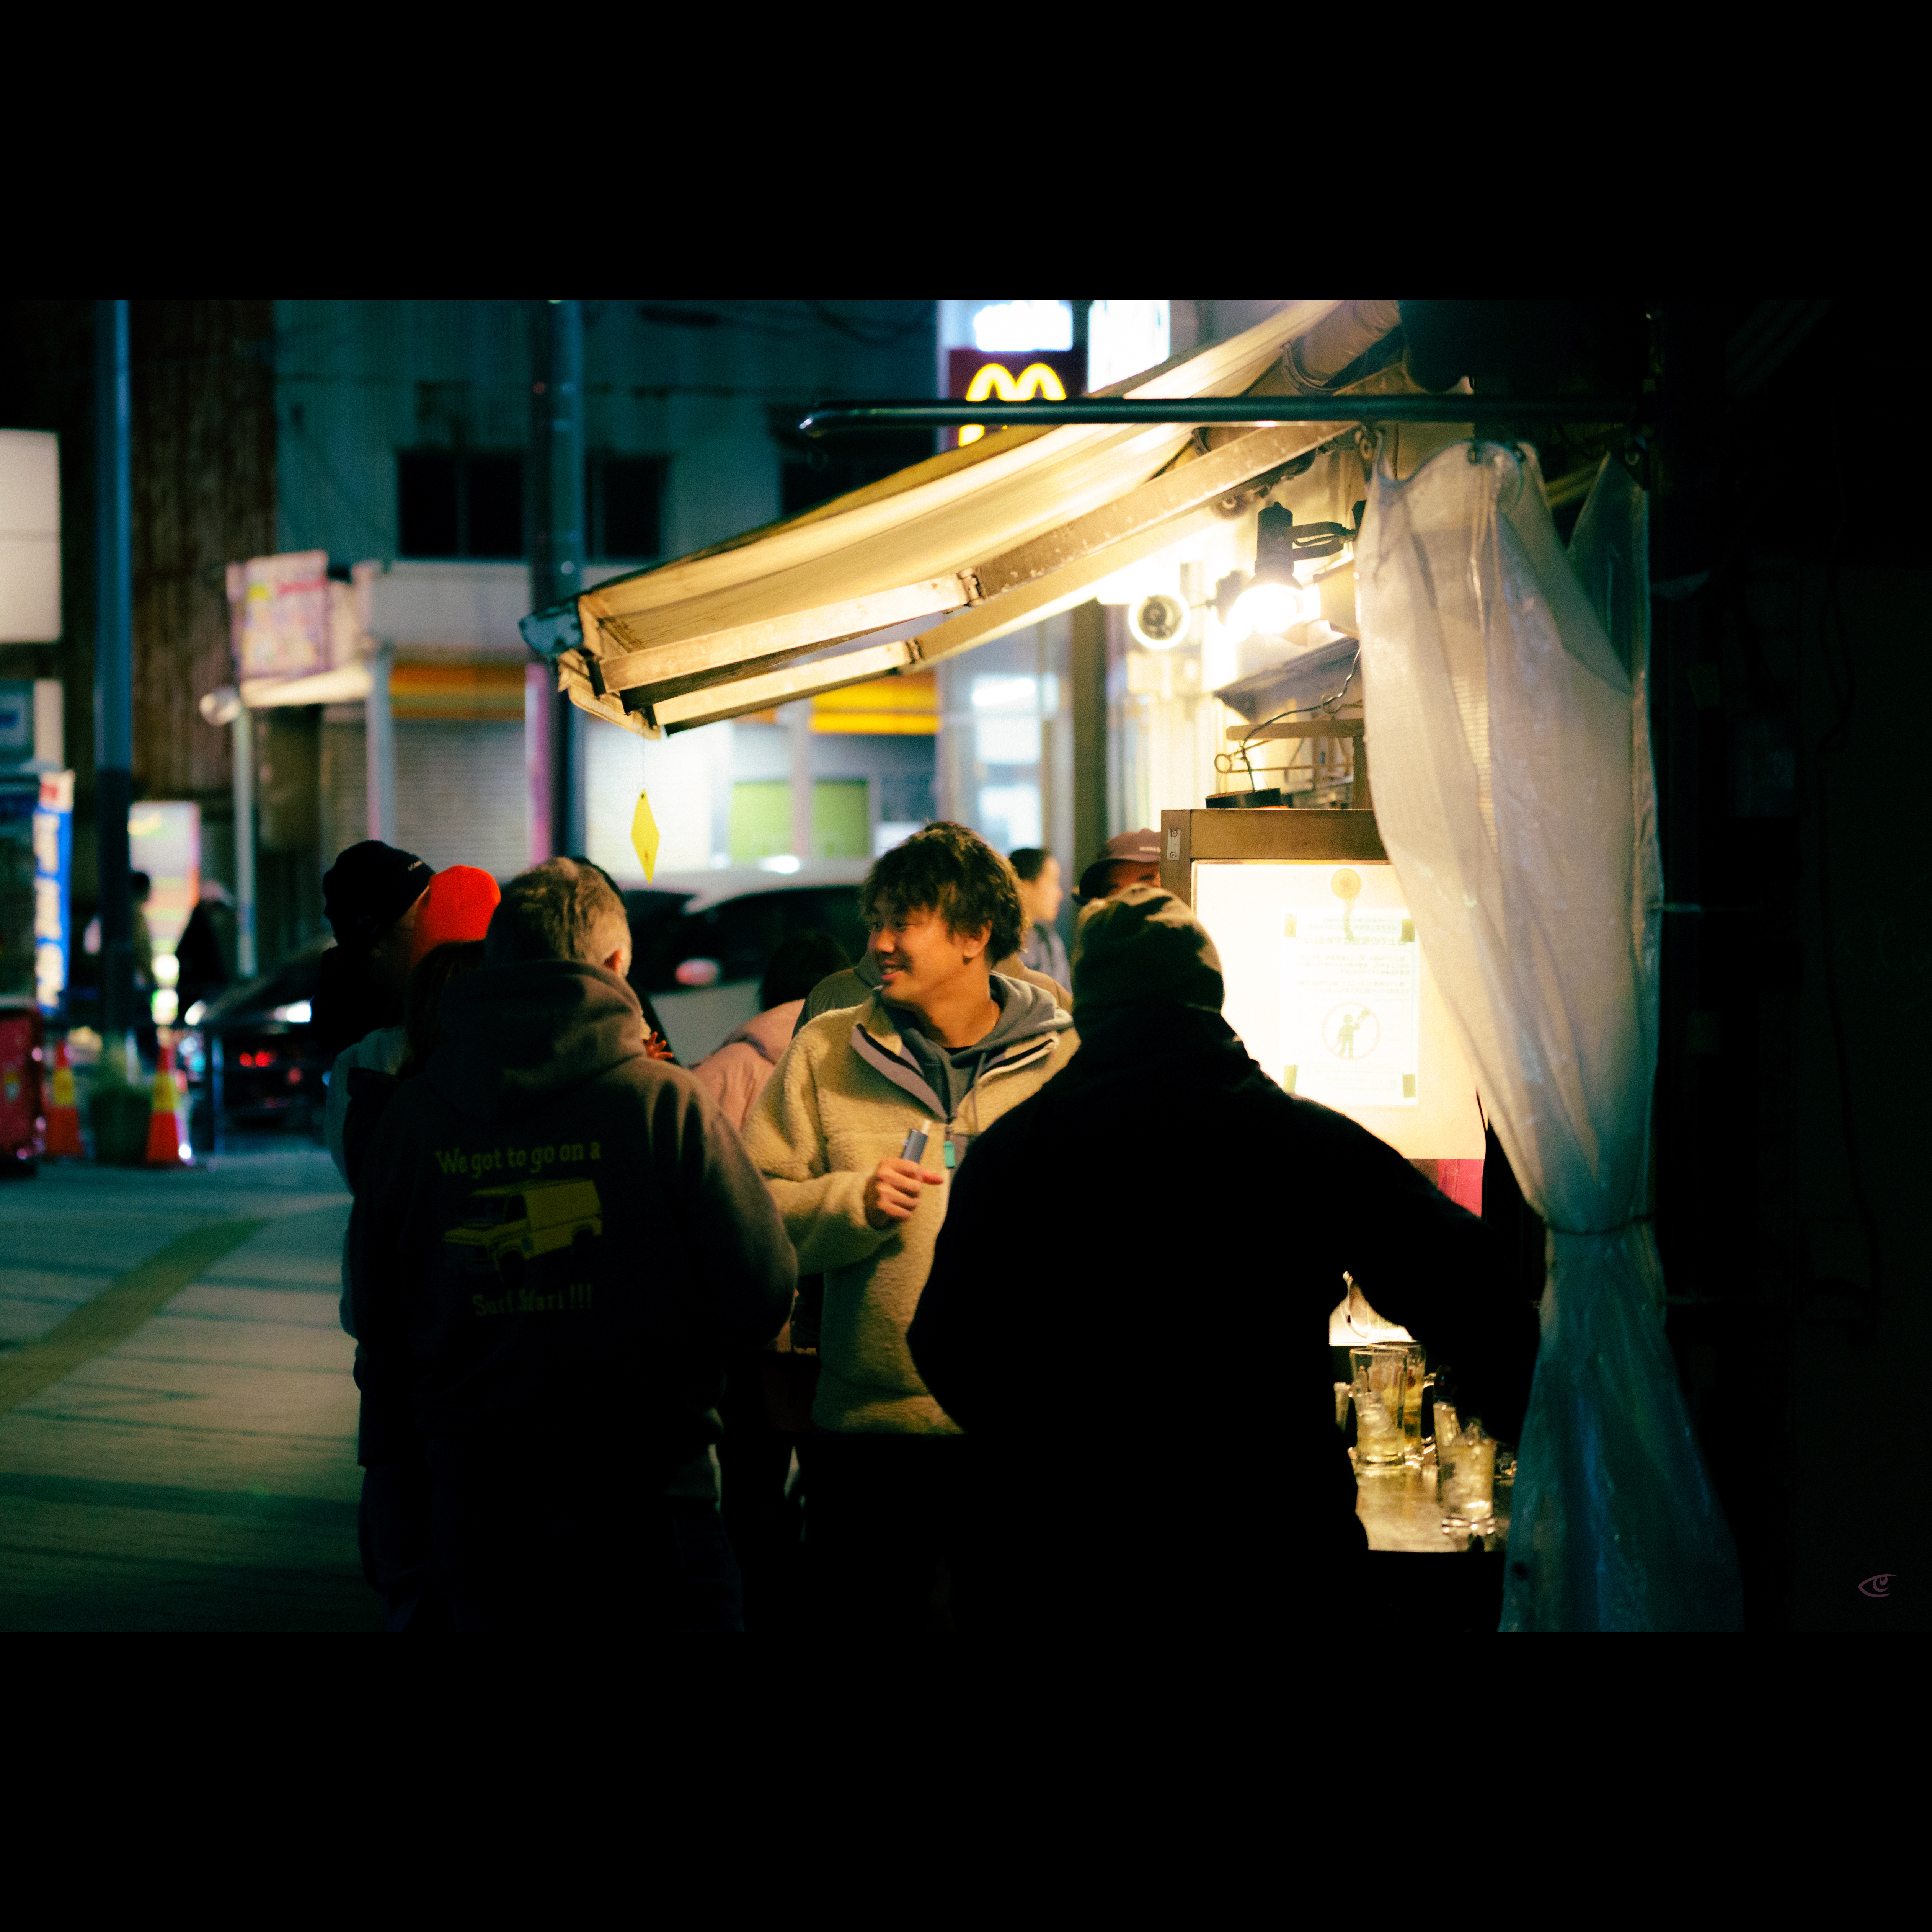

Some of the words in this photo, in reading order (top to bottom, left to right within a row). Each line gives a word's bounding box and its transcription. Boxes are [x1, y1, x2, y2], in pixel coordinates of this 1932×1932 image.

[433, 1147, 468, 1175] We
[471, 1148, 502, 1179] got
[507, 1147, 527, 1167] to
[530, 1145, 555, 1174] go
[559, 1142, 584, 1162] on
[589, 1141, 600, 1160] a
